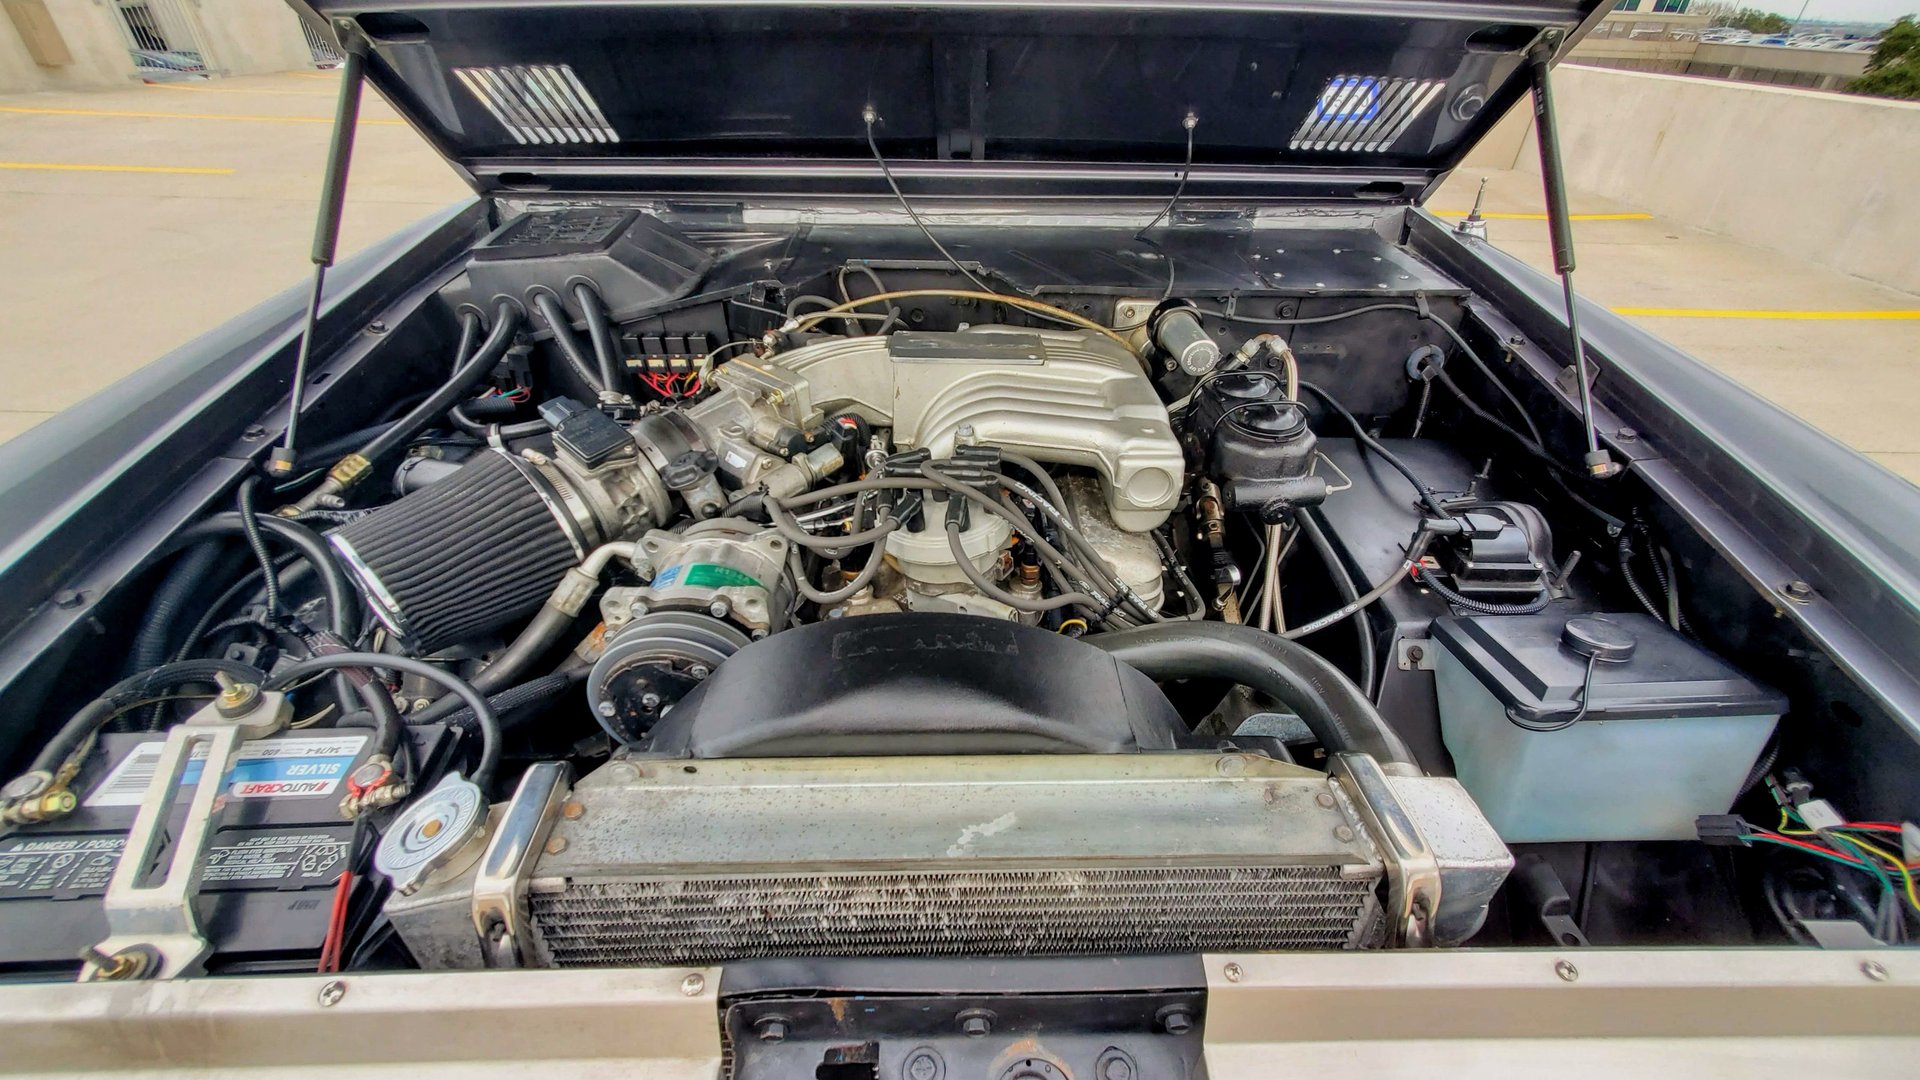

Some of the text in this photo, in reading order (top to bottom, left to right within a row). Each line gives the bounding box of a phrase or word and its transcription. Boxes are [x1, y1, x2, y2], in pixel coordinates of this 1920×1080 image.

[1015, 481, 1061, 518] RACING
[1302, 610, 1345, 633] RACING
[286, 762, 342, 776] SILVER
[239, 782, 319, 795] AUTOCRAFT
[23, 840, 78, 851] DANGER
[86, 839, 128, 849] POISO
